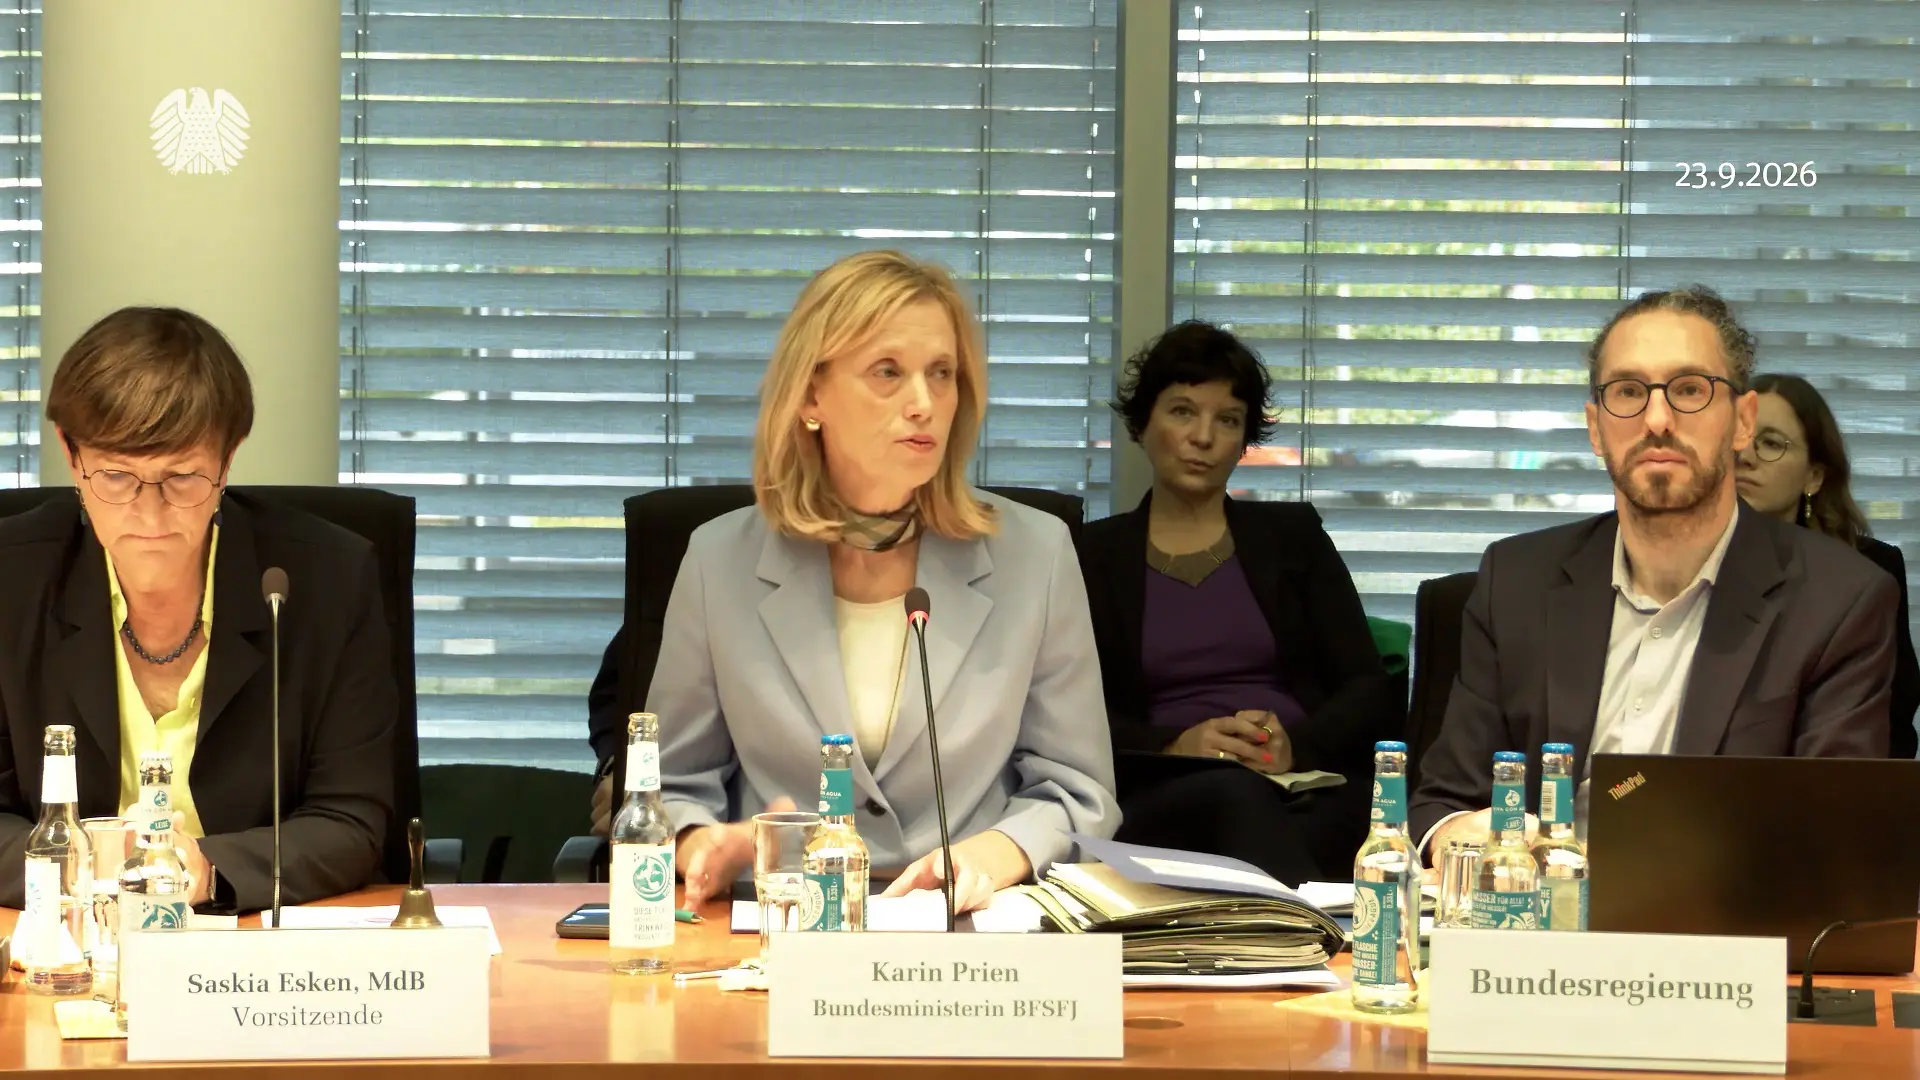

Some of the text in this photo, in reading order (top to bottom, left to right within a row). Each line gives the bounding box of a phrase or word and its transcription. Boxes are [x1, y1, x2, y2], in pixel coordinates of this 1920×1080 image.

[1607, 771, 1646, 800] ThinkPad
[188, 969, 426, 995] Saskia Esken, MdB
[871, 961, 1019, 982] Karin Prien
[1469, 967, 1754, 1010] Bundesregierung
[231, 1003, 384, 1028] Vorsitzende
[812, 998, 1078, 1022] Bundesministerin BFSFJ
